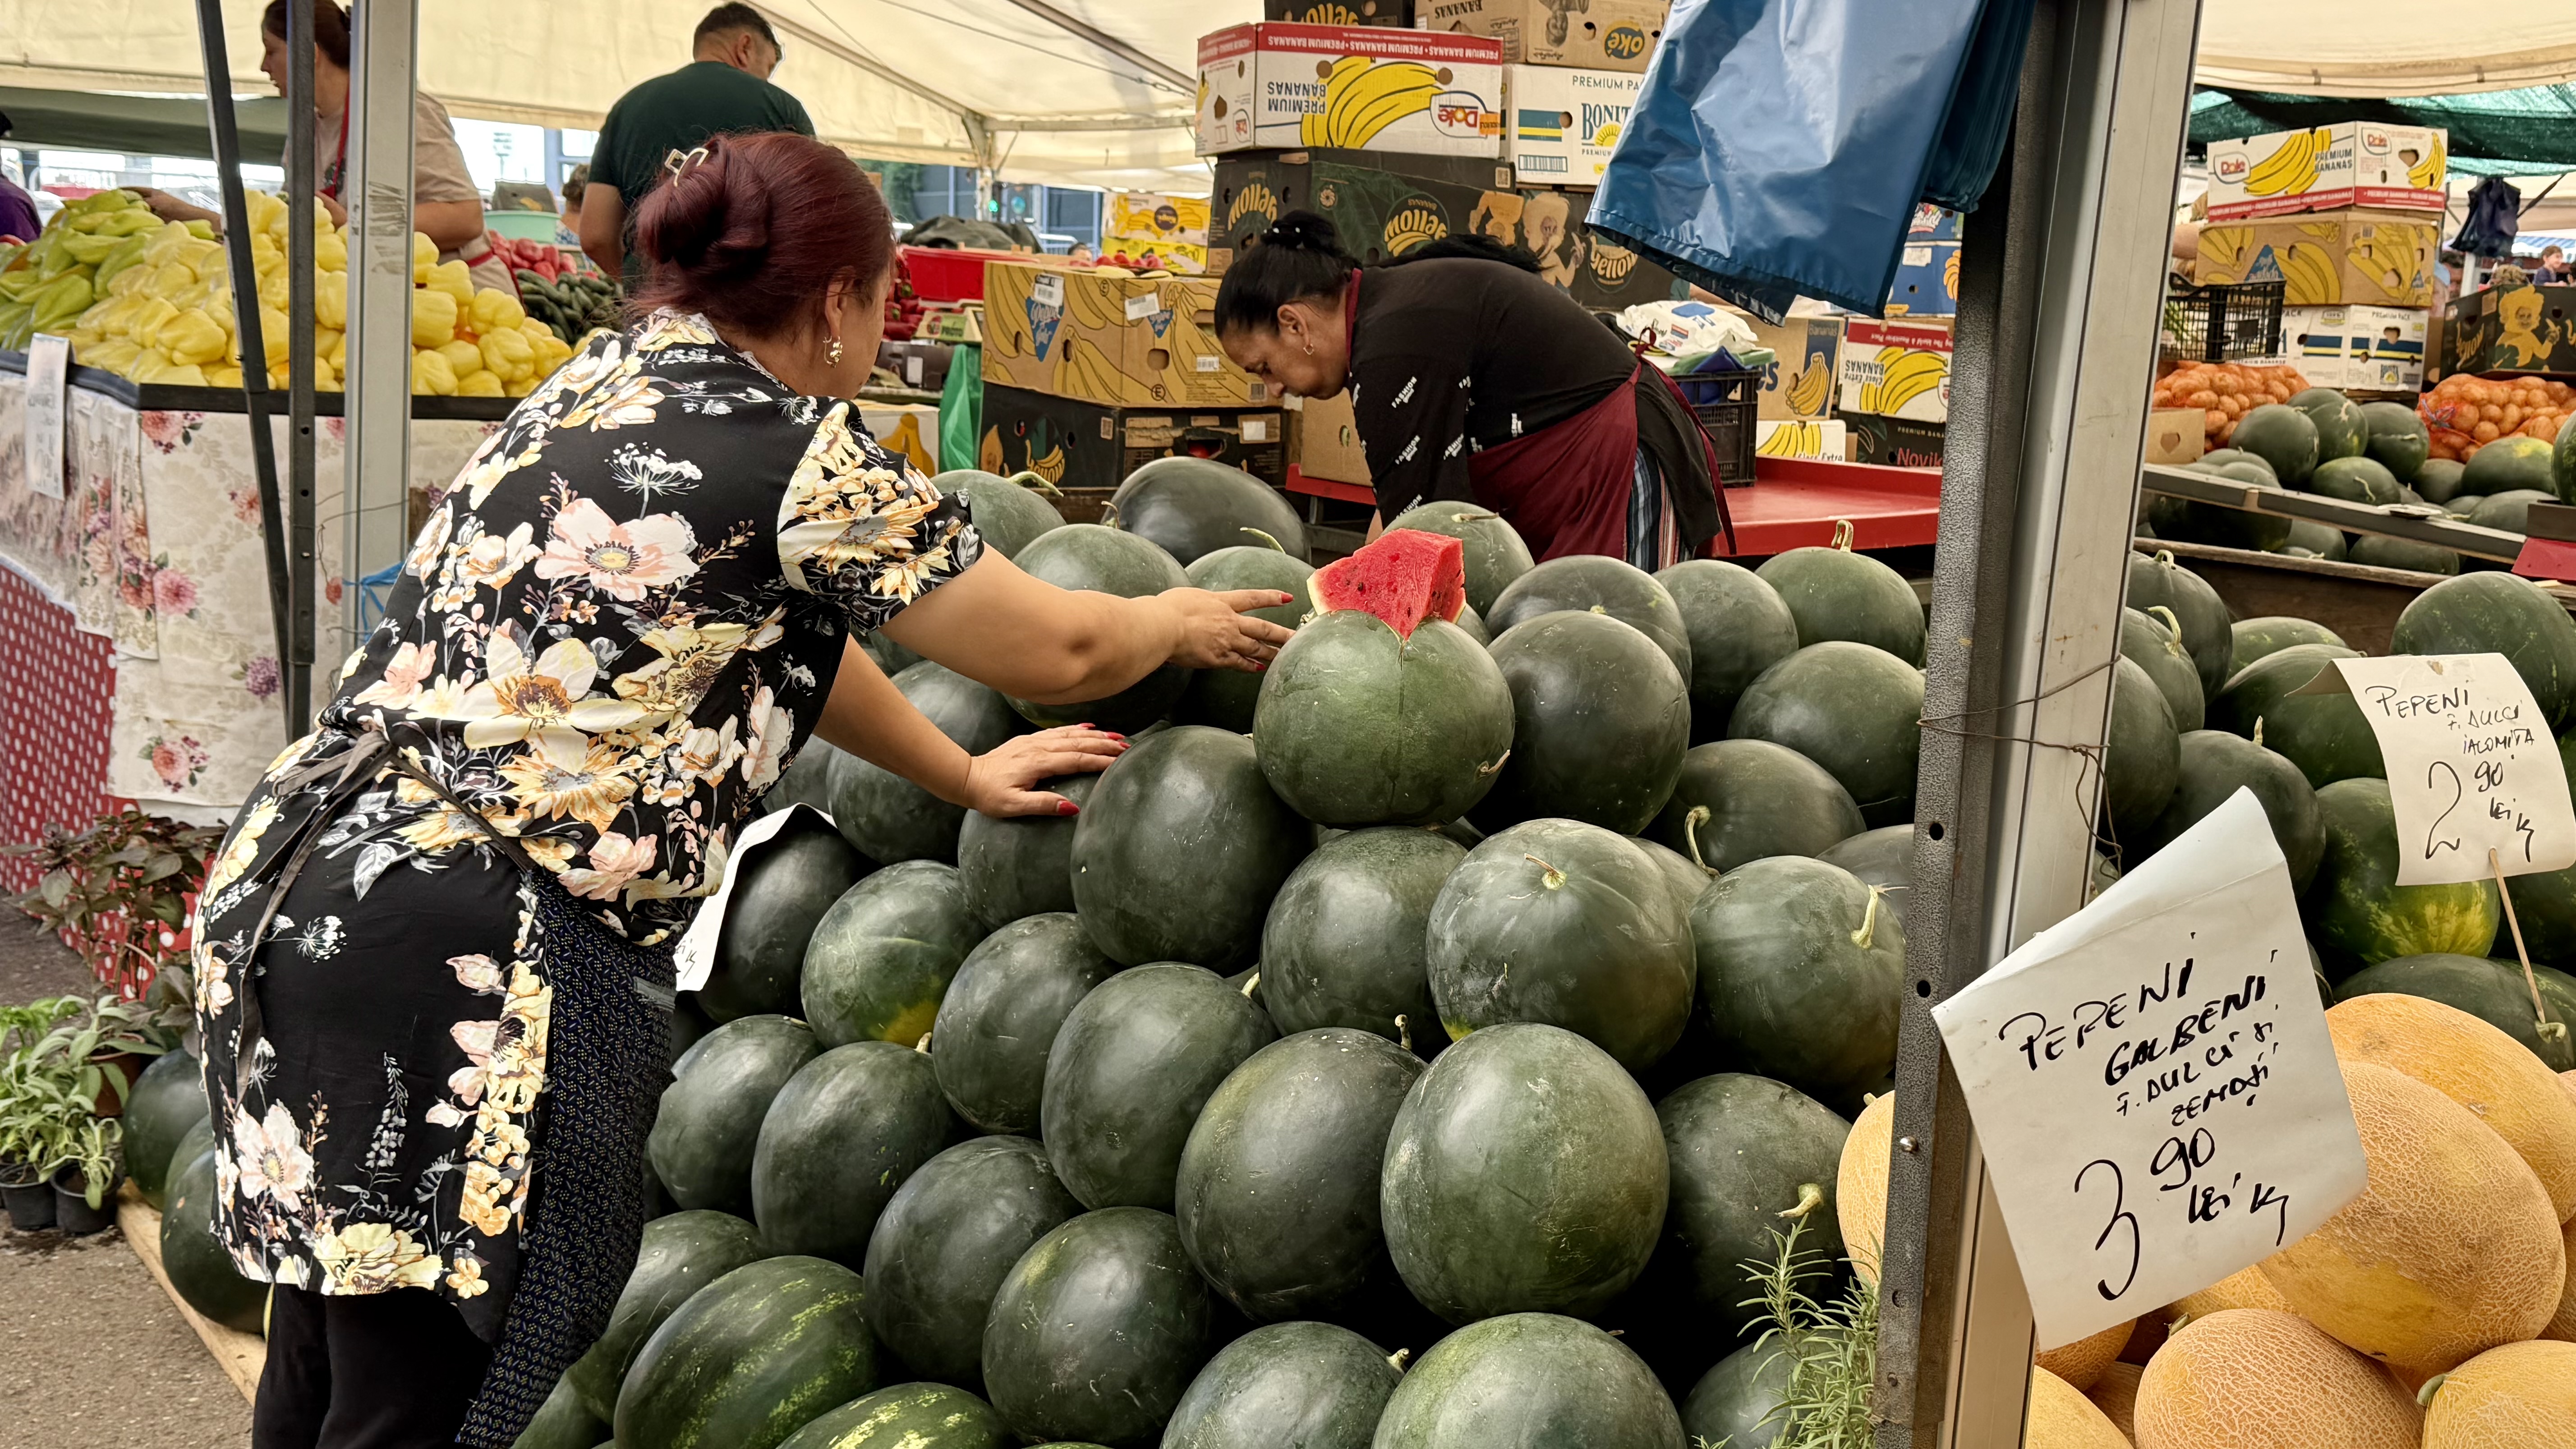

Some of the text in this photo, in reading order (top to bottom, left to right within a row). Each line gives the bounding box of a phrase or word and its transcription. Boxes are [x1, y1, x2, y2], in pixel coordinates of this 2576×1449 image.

[1435, 0, 1482, 19] BANANAS
[1267, 81, 1326, 97] BANANAS
[1573, 75, 1623, 90] PREMIUM
[1268, 98, 1326, 114] PREMIUM
[1438, 107, 1478, 128] Dole
[2315, 148, 2352, 161] PREMIUM
[2221, 158, 2245, 174] Dole
[2314, 159, 2352, 173] BANANAS
[1384, 209, 1447, 243] yellow
[1845, 360, 1884, 376] BANANAS
[1897, 426, 1926, 436] PREMIUM
[2365, 679, 2469, 718] PEPENI
[2425, 760, 2504, 860] 2 90
[1998, 931, 2195, 1071] PEPENI
[2105, 948, 2280, 1086] GALBENI
[2075, 1127, 2216, 1301] 3 90
